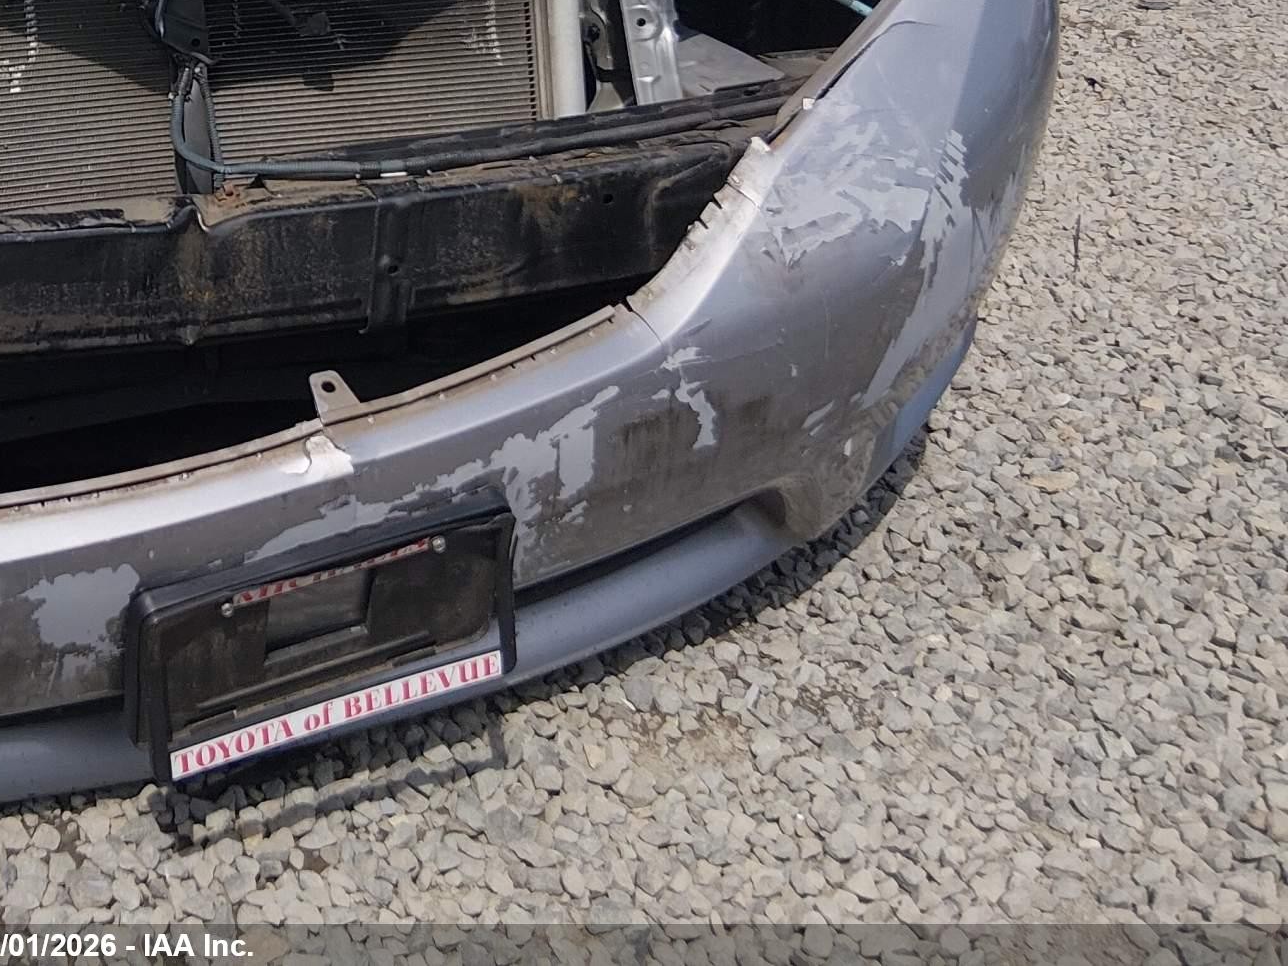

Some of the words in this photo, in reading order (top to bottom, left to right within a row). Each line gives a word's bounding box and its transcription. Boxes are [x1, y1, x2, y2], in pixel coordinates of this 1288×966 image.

[173, 718, 294, 773] TOYOTA
[303, 705, 332, 732] of
[344, 655, 498, 718] BELLEVUE
